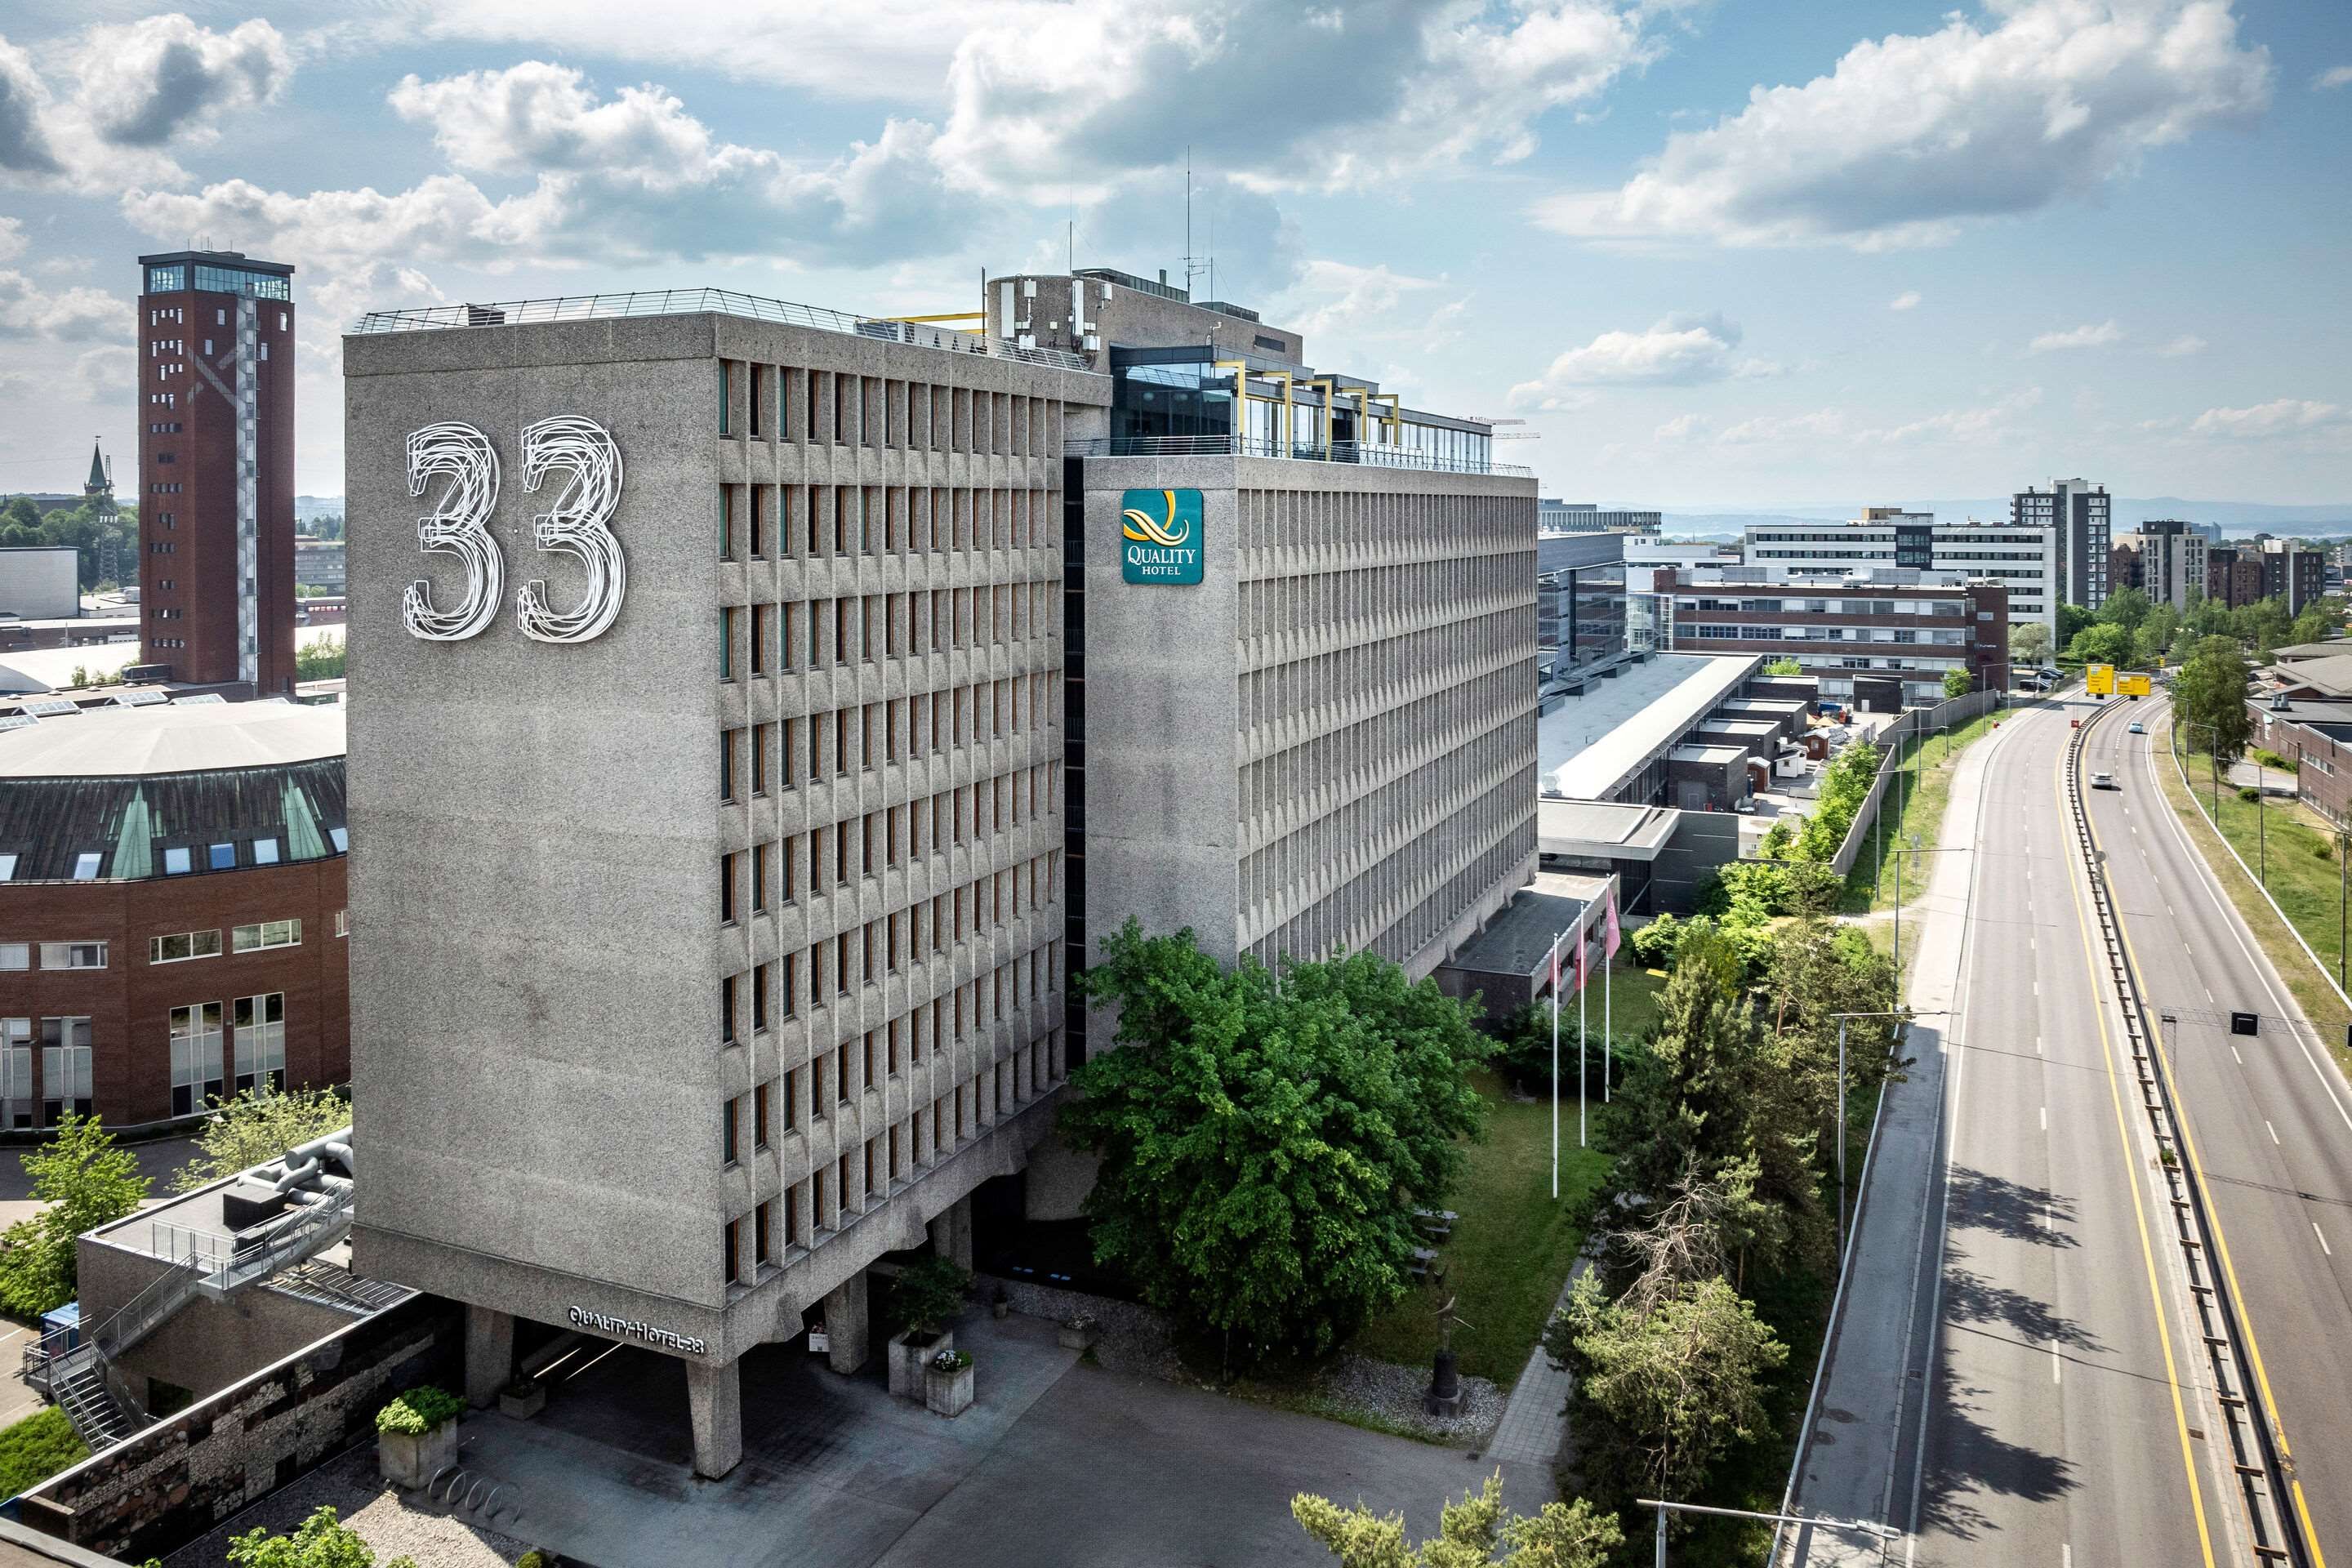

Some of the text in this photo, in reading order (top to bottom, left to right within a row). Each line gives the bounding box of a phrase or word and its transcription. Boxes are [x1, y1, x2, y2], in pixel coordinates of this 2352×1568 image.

[403, 414, 626, 644] 33
[1127, 545, 1196, 566] QUALITY
[1142, 566, 1181, 576] HOTEL
[569, 1305, 704, 1354] QUALITY HOTEL 33
